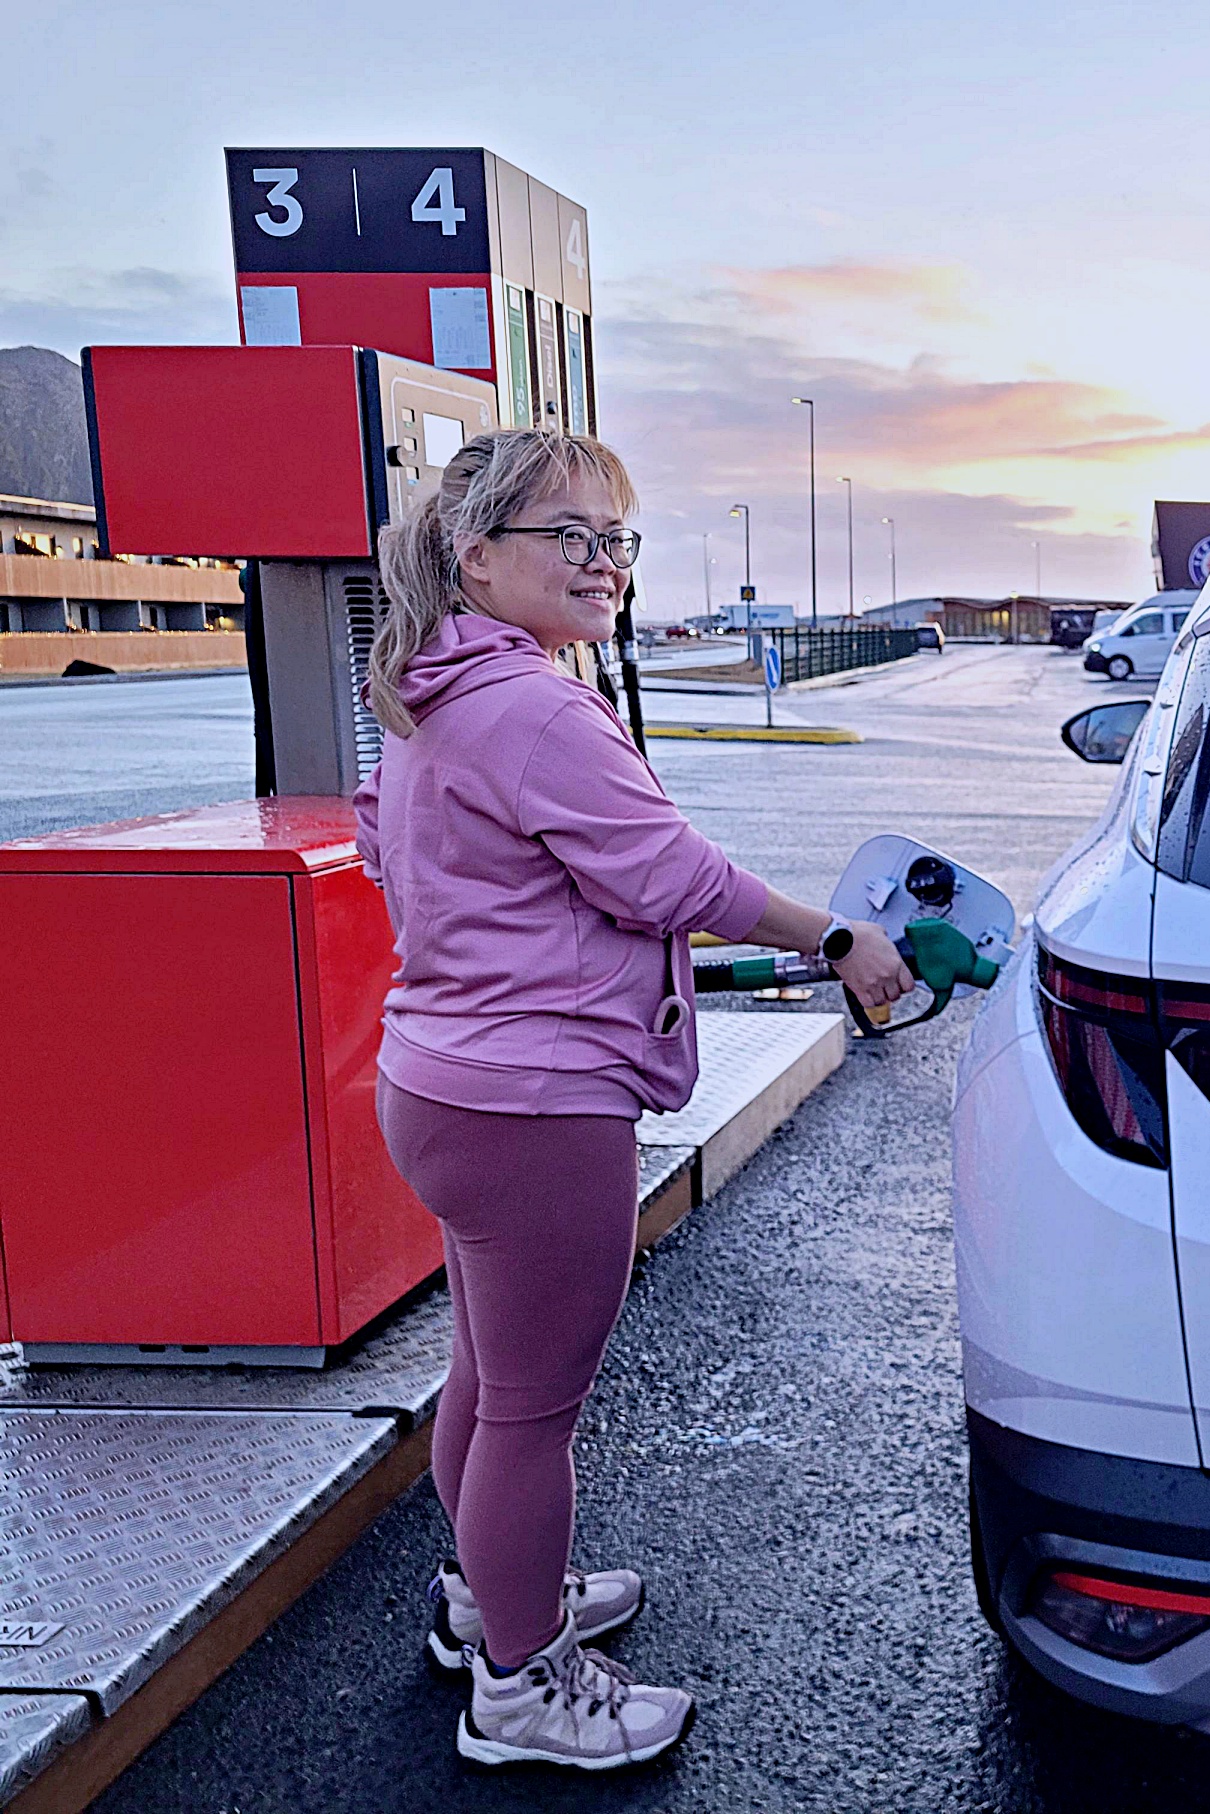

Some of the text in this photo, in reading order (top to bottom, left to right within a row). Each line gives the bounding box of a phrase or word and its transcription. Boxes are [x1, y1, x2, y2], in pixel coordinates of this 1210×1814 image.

[253, 167, 466, 237] 3 4
[566, 218, 585, 279] 4
[516, 388, 526, 416] 95
